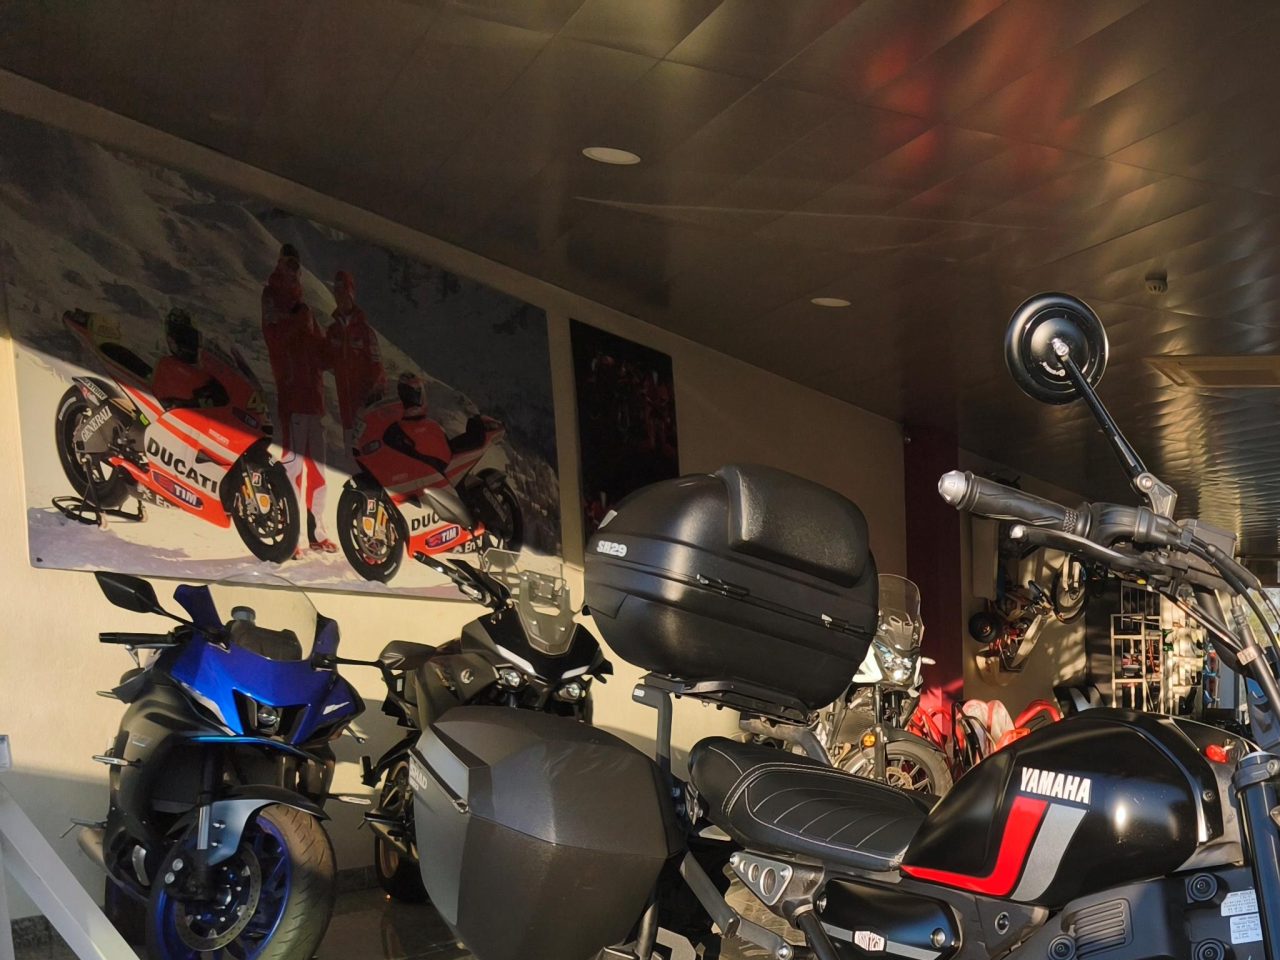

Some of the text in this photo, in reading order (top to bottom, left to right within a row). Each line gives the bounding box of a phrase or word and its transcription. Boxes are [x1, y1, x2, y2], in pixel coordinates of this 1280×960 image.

[80, 405, 113, 442] GENERALI
[146, 437, 218, 494] DUCATI
[172, 483, 198, 507] TIM
[411, 513, 440, 531] DUC
[441, 526, 458, 543] TIM
[1020, 766, 1092, 804] YAMAHA
